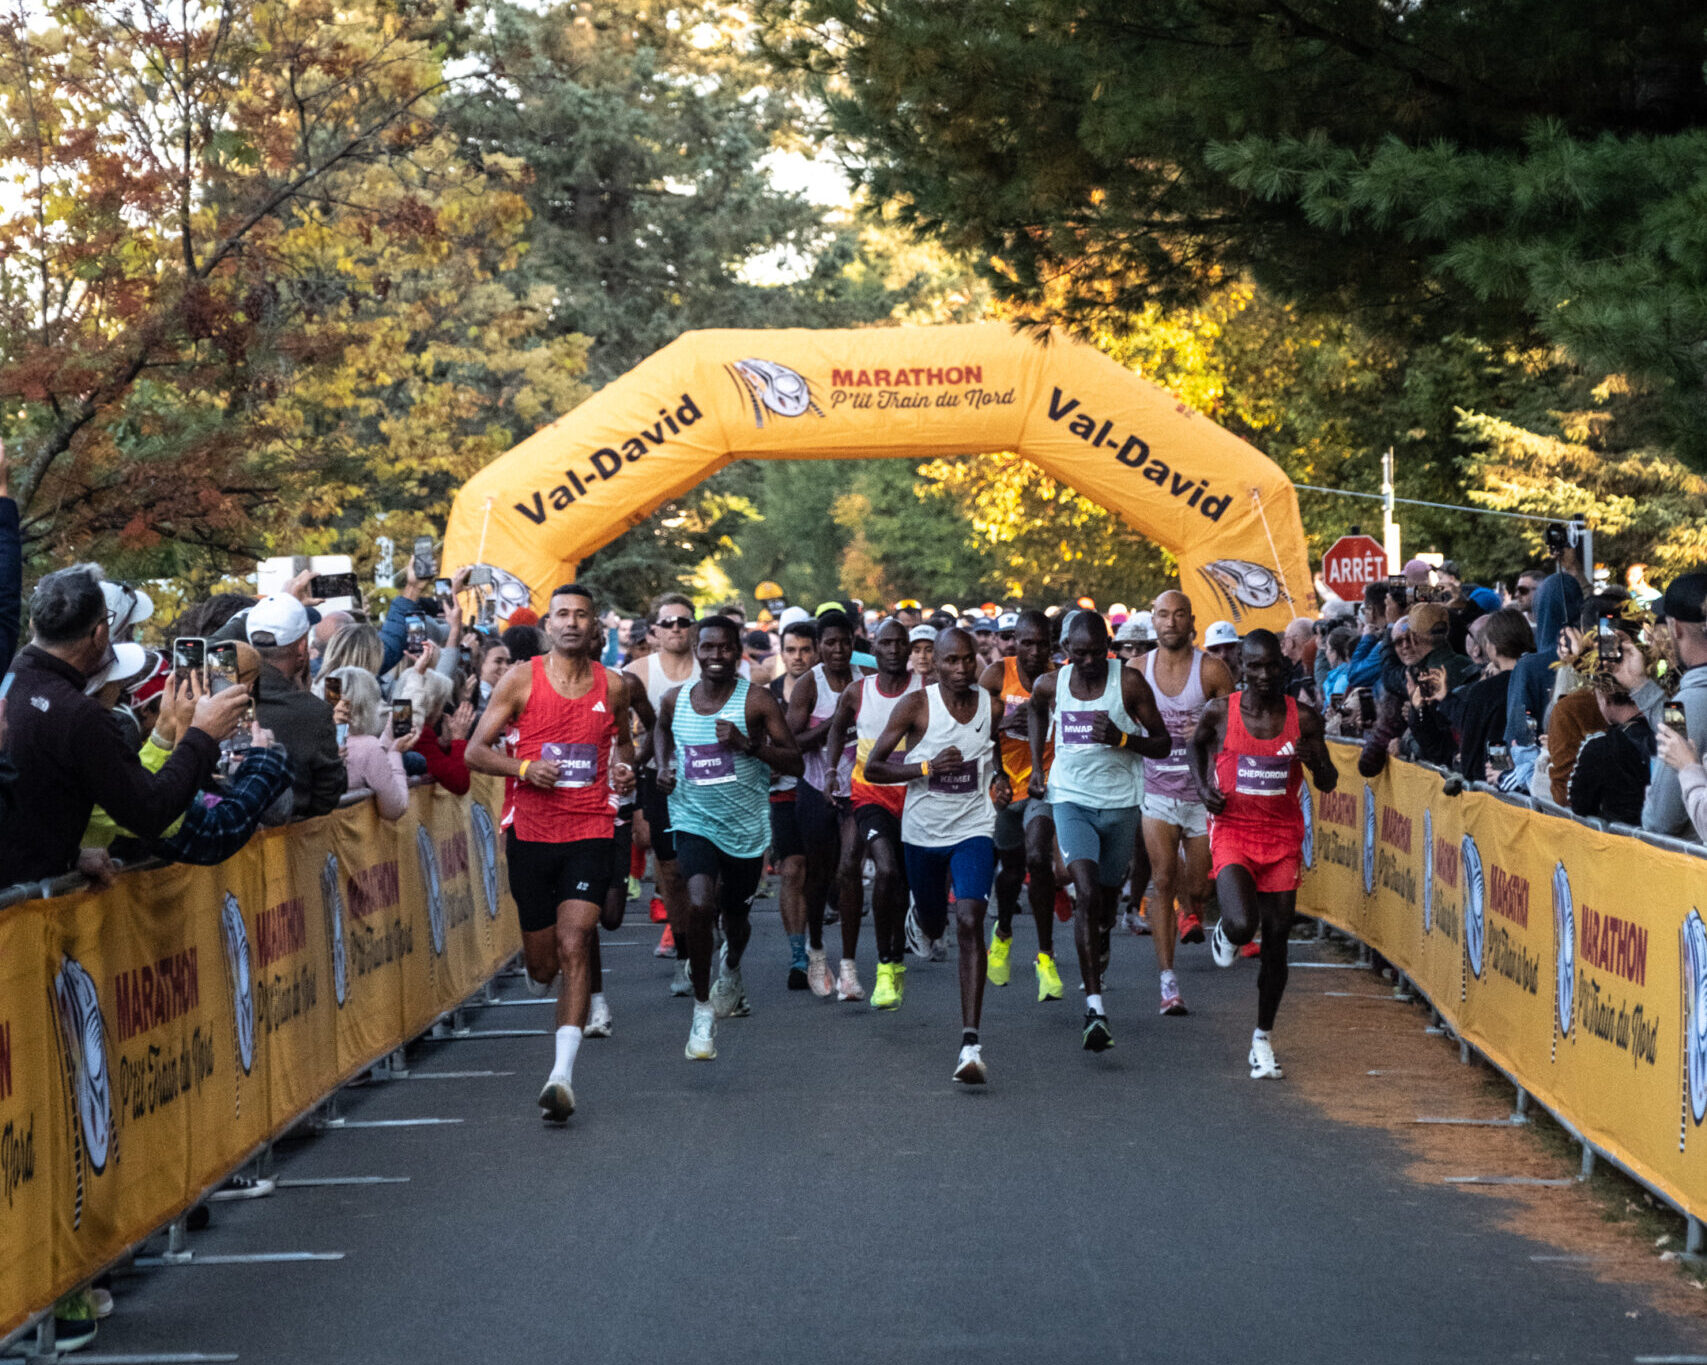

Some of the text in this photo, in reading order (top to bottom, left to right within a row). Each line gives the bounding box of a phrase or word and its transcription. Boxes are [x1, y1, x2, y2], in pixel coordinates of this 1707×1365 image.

[831, 387, 1016, 409] P'tit Train du Nord
[832, 366, 982, 387] MARATHON
[513, 393, 703, 525] Val-David
[1048, 386, 1234, 522] Val-David
[1329, 550, 1383, 582] ARRÊT
[1064, 725, 1093, 733] MWAP
[691, 757, 722, 768] KIPTIS
[1580, 904, 1648, 987] MARATHON
[115, 946, 199, 1043] MARATHON
[1632, 1003, 1660, 1070] Nord
